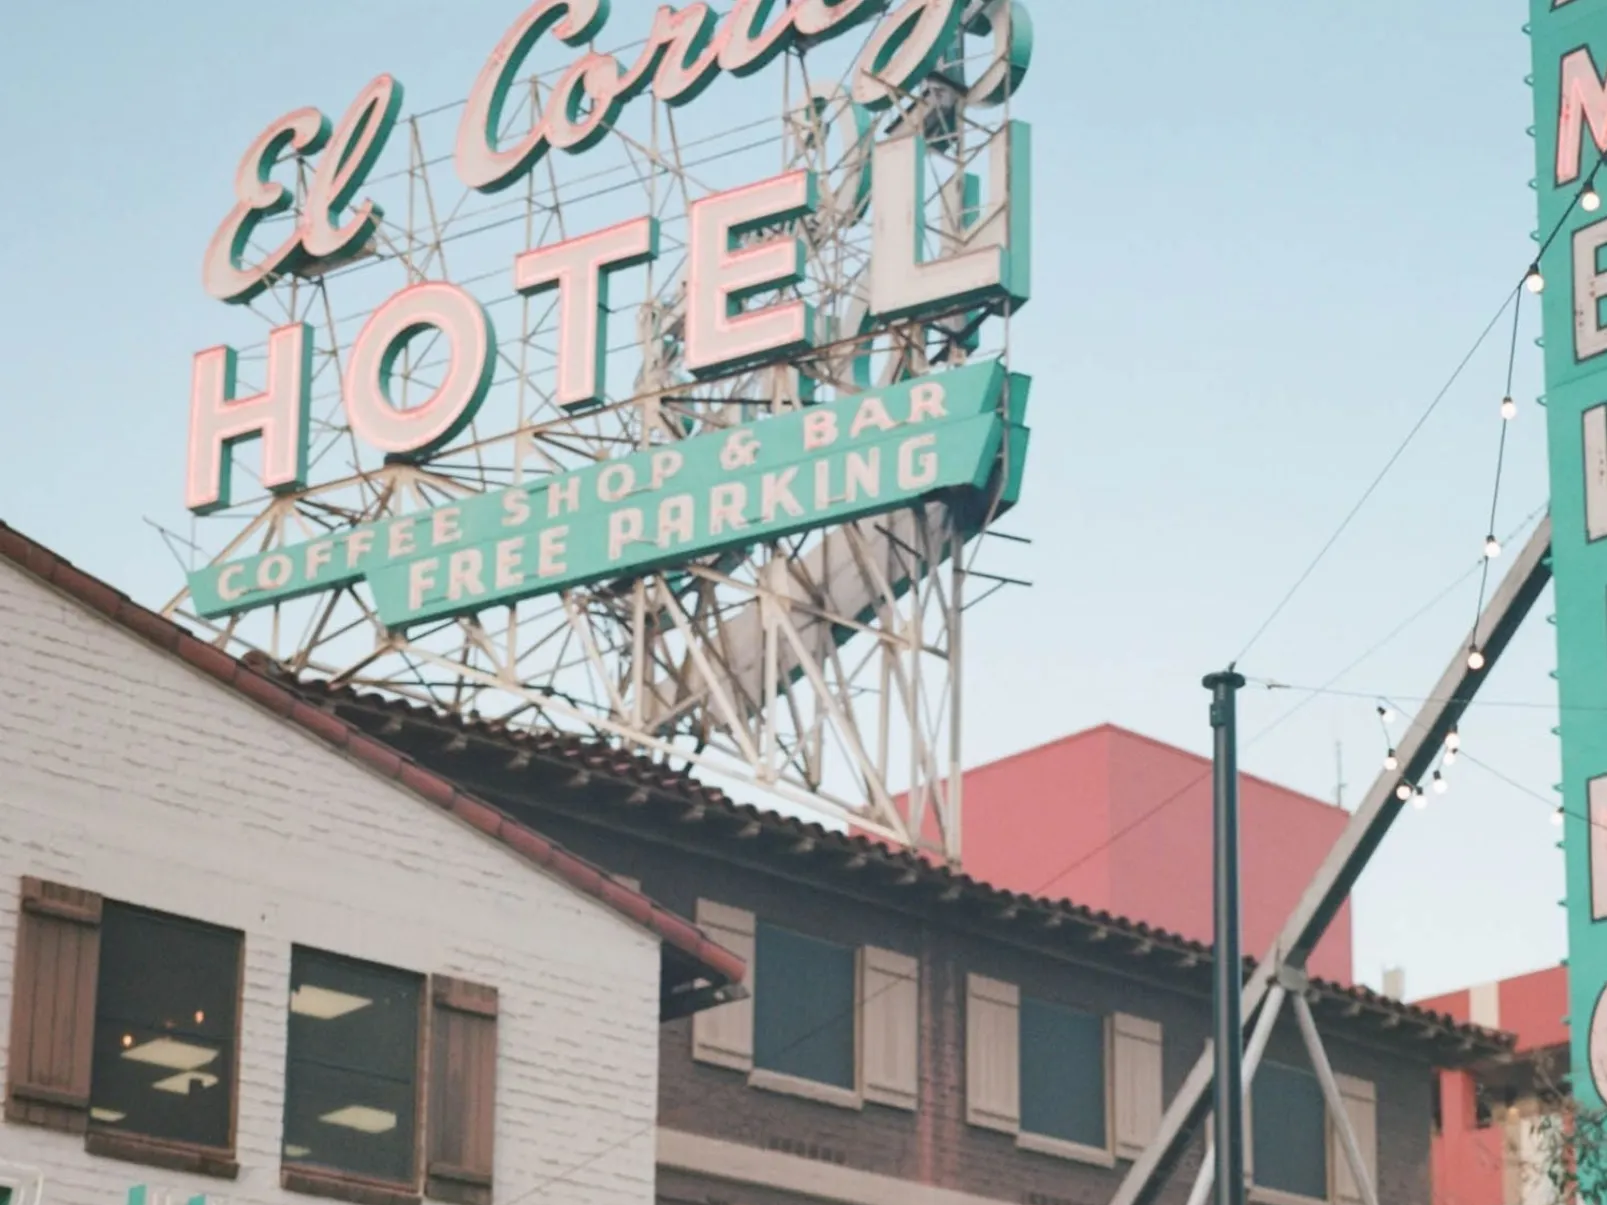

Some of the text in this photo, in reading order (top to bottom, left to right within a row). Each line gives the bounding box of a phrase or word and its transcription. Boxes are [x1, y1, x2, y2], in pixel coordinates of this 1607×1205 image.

[203, 74, 404, 303] El
[186, 132, 1010, 514] HOTEL
[216, 381, 948, 600] COFFEE SHOP & BAR
[408, 433, 939, 610] FREE PARKING
